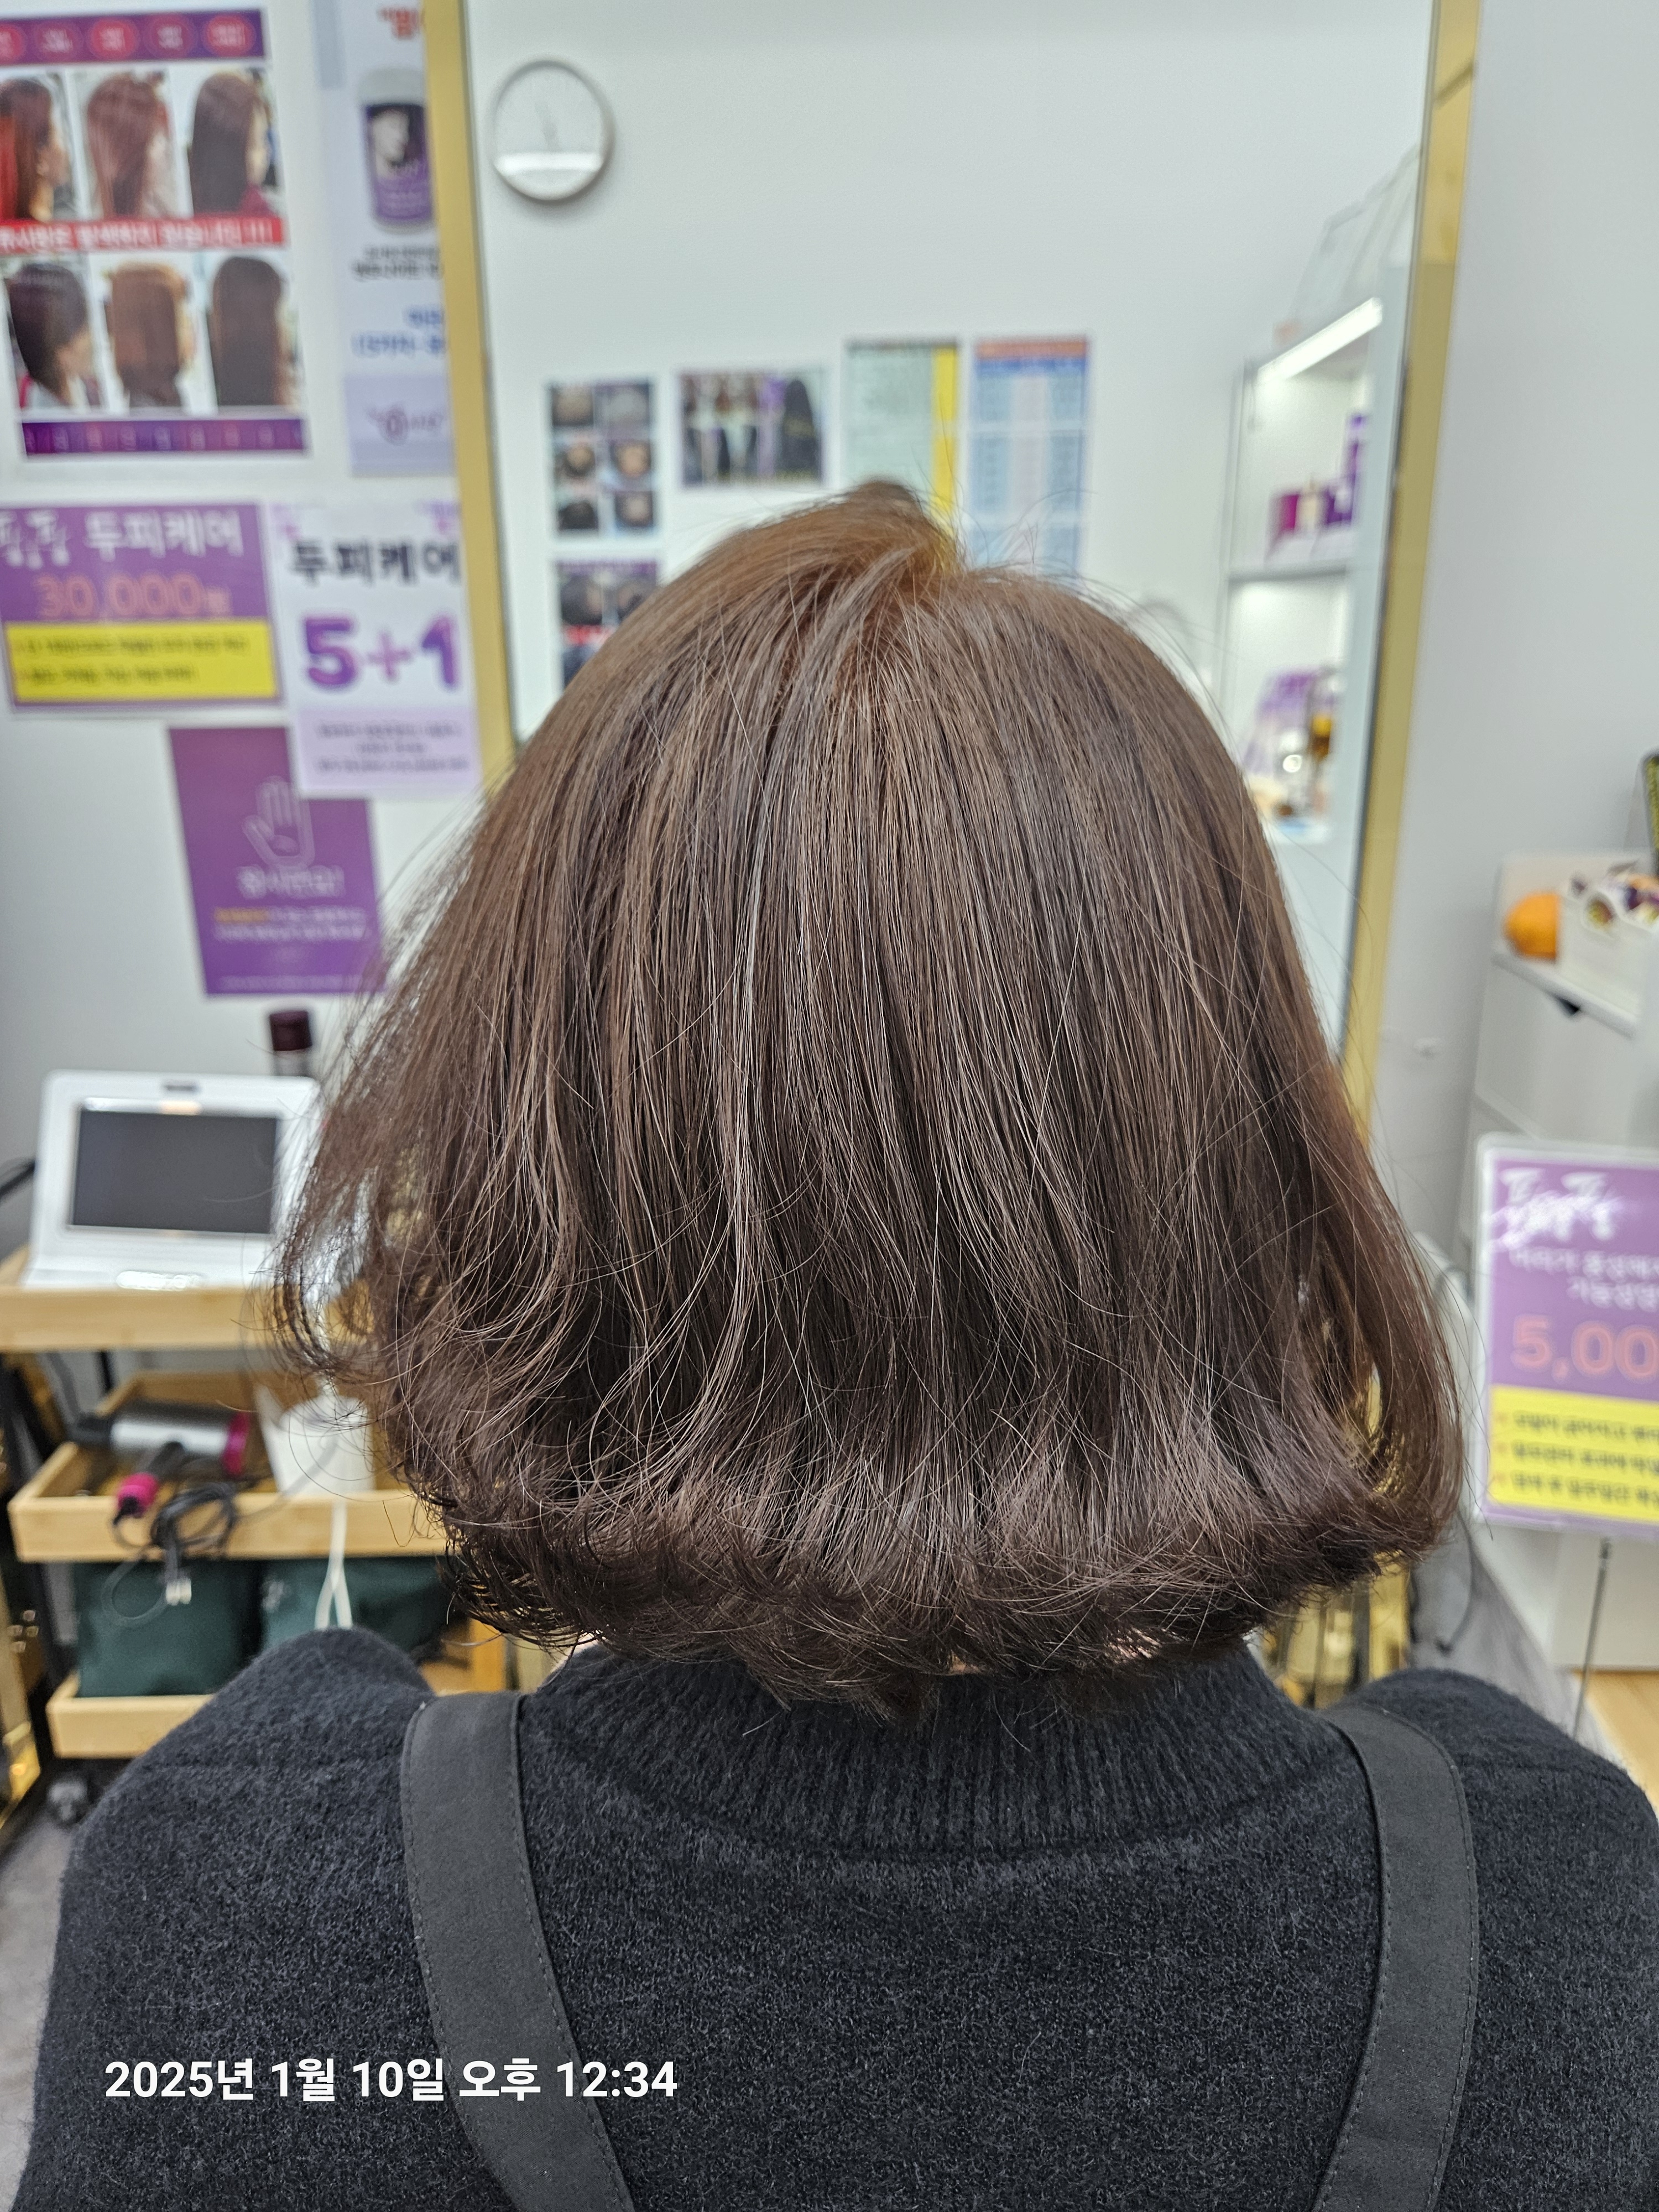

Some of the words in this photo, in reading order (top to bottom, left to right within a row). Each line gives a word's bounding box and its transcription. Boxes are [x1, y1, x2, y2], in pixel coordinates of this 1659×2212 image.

[86, 511, 243, 561] 두피케어
[293, 539, 461, 586] 두피케어
[304, 614, 458, 690] 5+1
